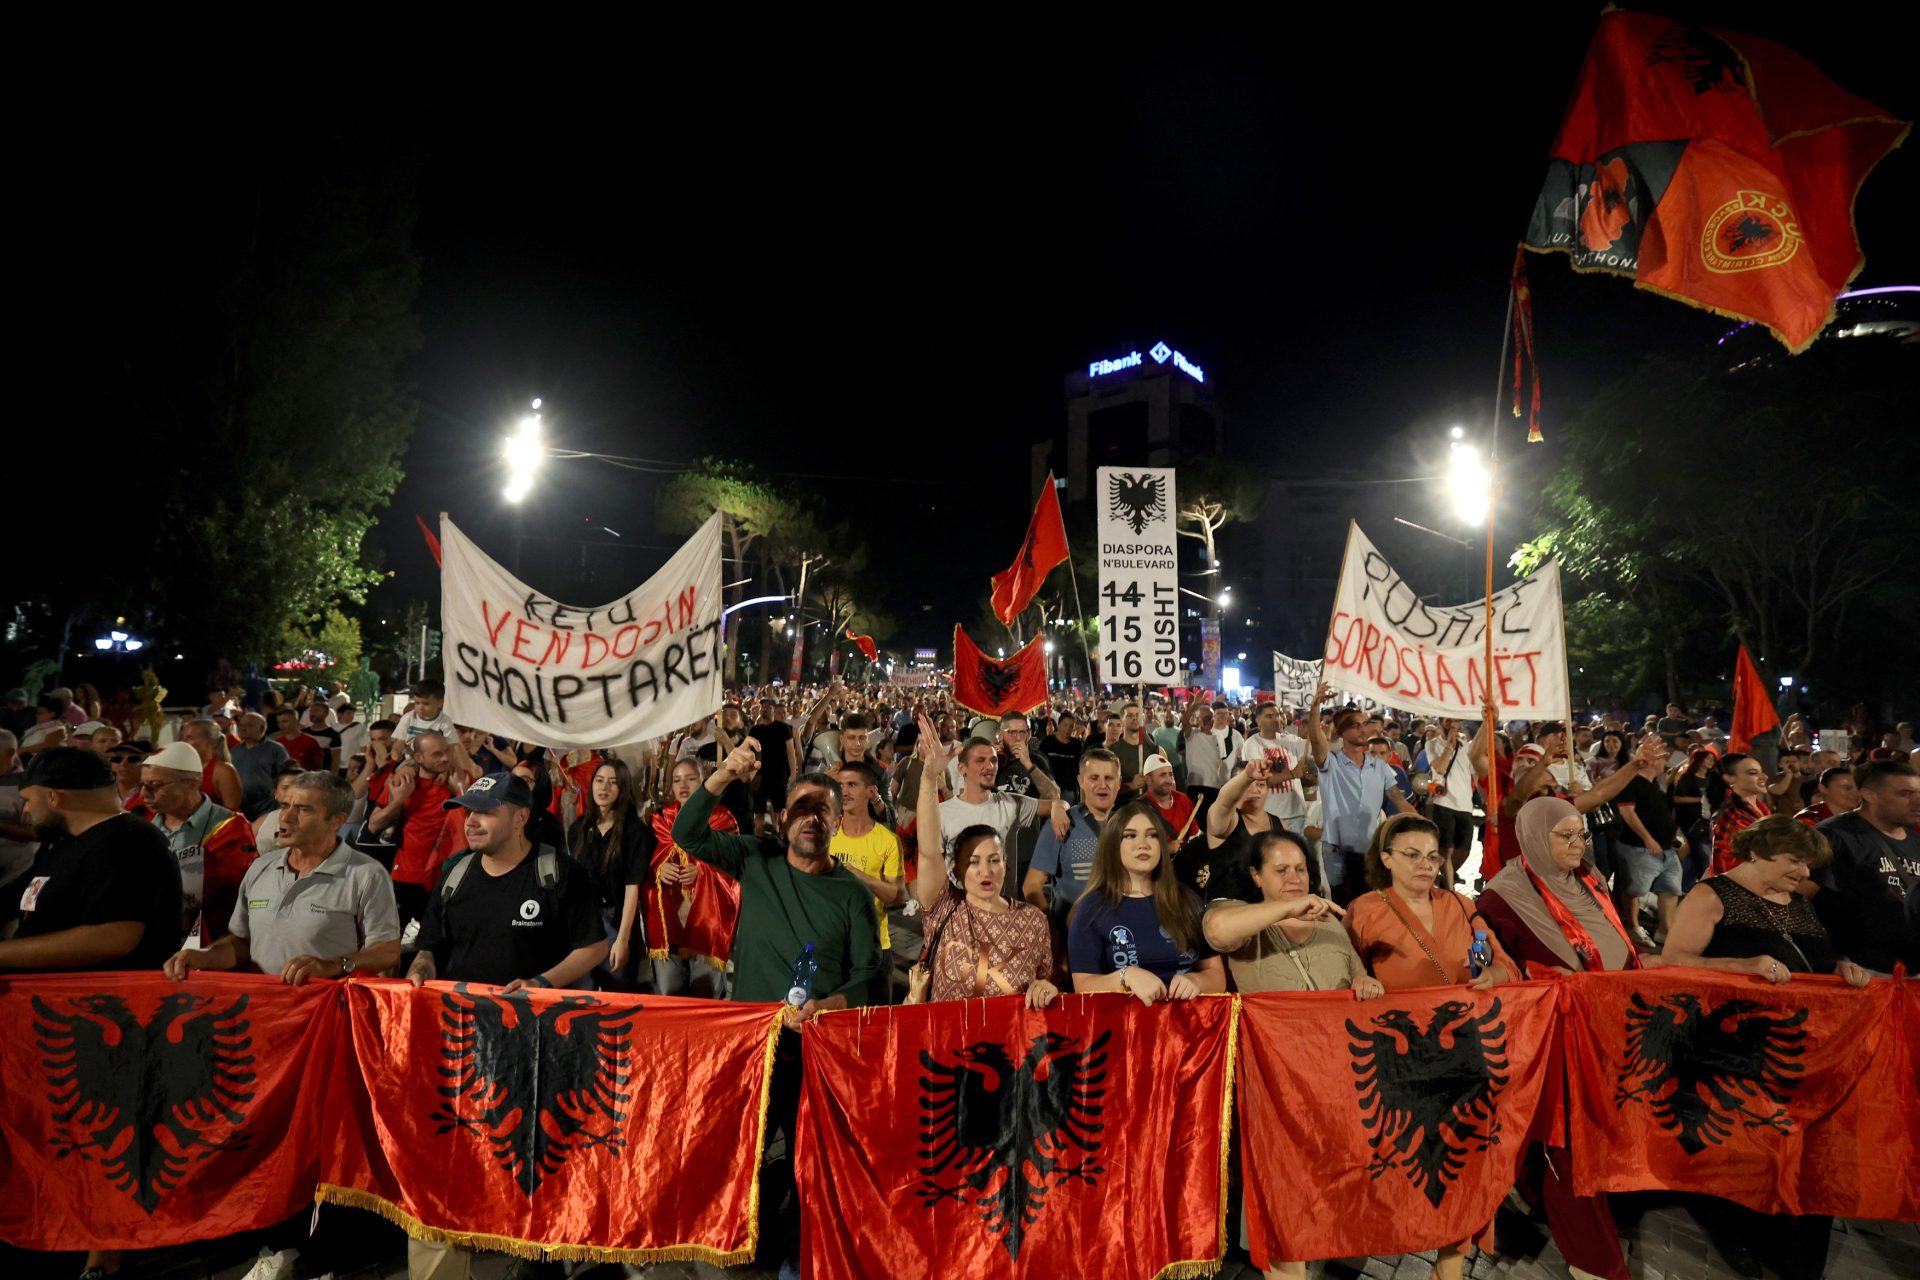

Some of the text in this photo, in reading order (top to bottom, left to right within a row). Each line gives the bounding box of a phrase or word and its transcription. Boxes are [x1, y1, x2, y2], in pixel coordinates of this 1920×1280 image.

[1089, 351, 1142, 377] Fibank
[1103, 543, 1173, 556] DIASPORA
[1103, 559, 1175, 570] N'BULEVARD
[1102, 580, 1142, 607] 14
[1104, 615, 1142, 642] 15
[1153, 581, 1176, 677] GUSHT
[1104, 650, 1142, 677] 16
[511, 919, 544, 927] Brainstorm
